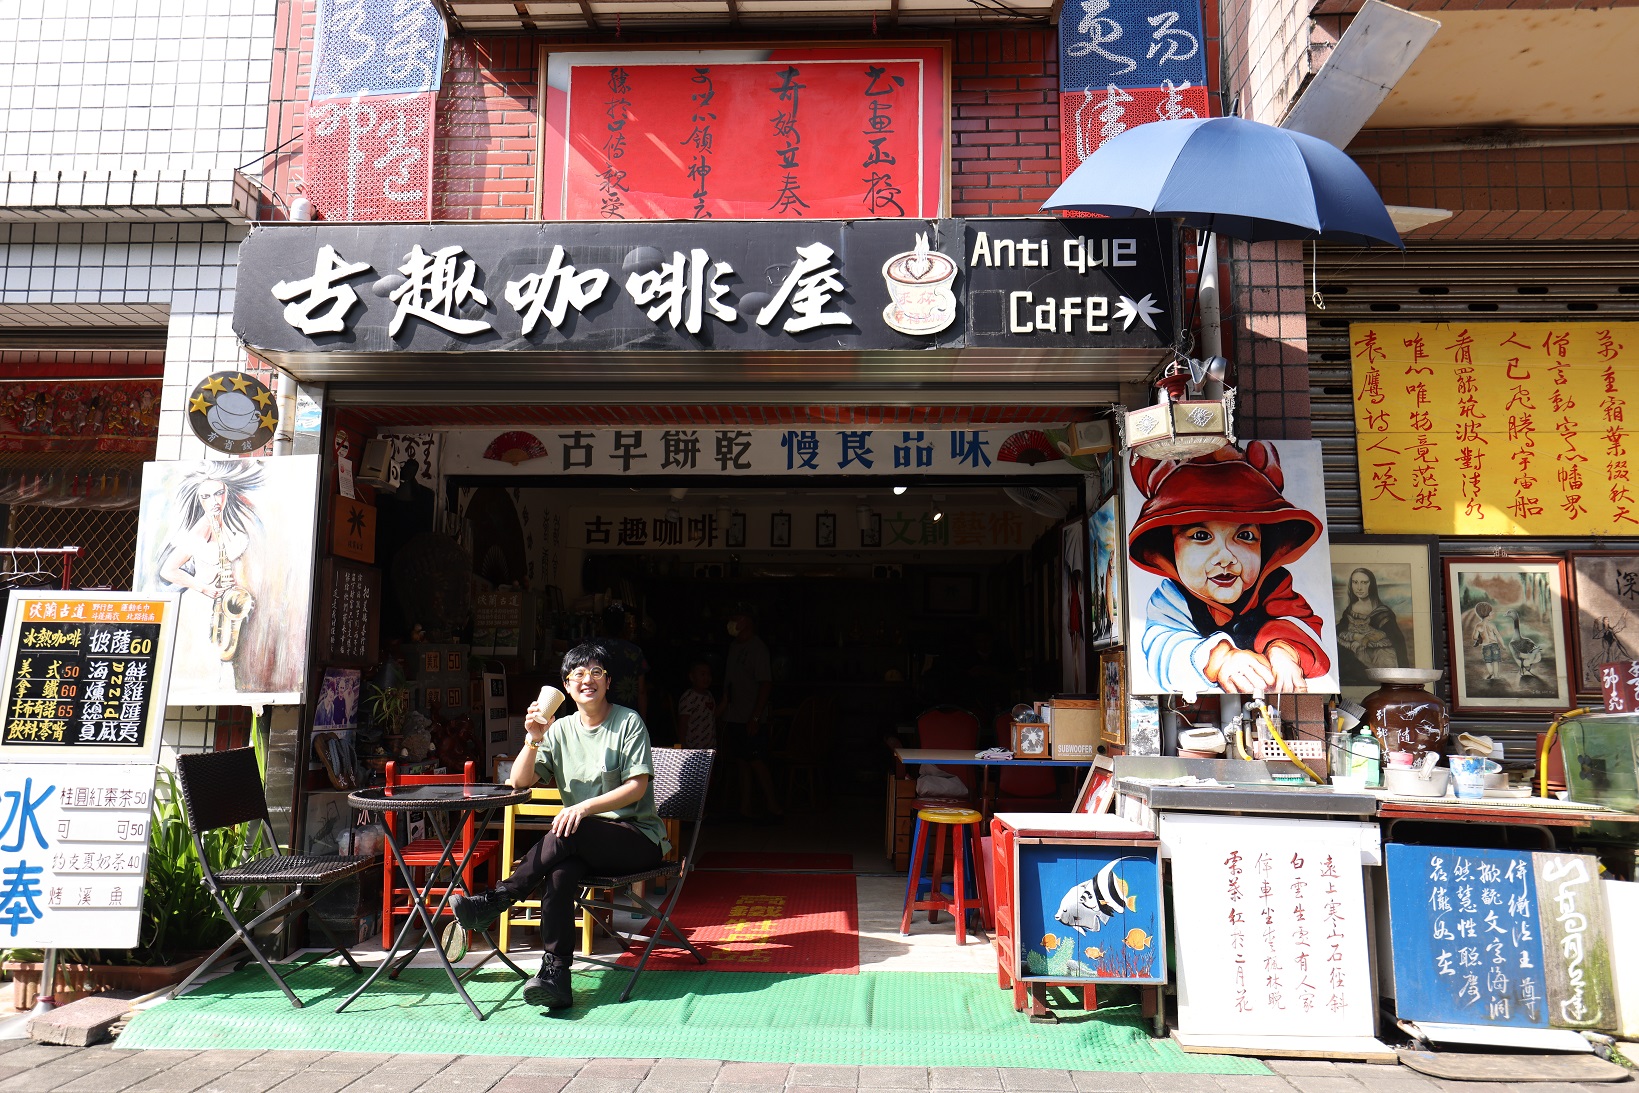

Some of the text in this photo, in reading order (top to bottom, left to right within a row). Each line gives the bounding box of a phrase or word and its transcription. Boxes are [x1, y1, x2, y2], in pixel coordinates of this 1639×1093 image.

[271, 242, 853, 338] 古趣咖啡屋
[1009, 291, 1111, 332] Cafe
[558, 429, 992, 472] 古早餅乾 慢食品味
[585, 513, 719, 548] 古趣咖啡
[884, 511, 1023, 547] 文創藝術
[23, 628, 82, 648] 冰熱咖啡
[448, 653, 460, 670] 50
[448, 689, 460, 706] 60
[79, 721, 140, 742] 夏威夷
[1057, 744, 1093, 753] SUBWOOFER
